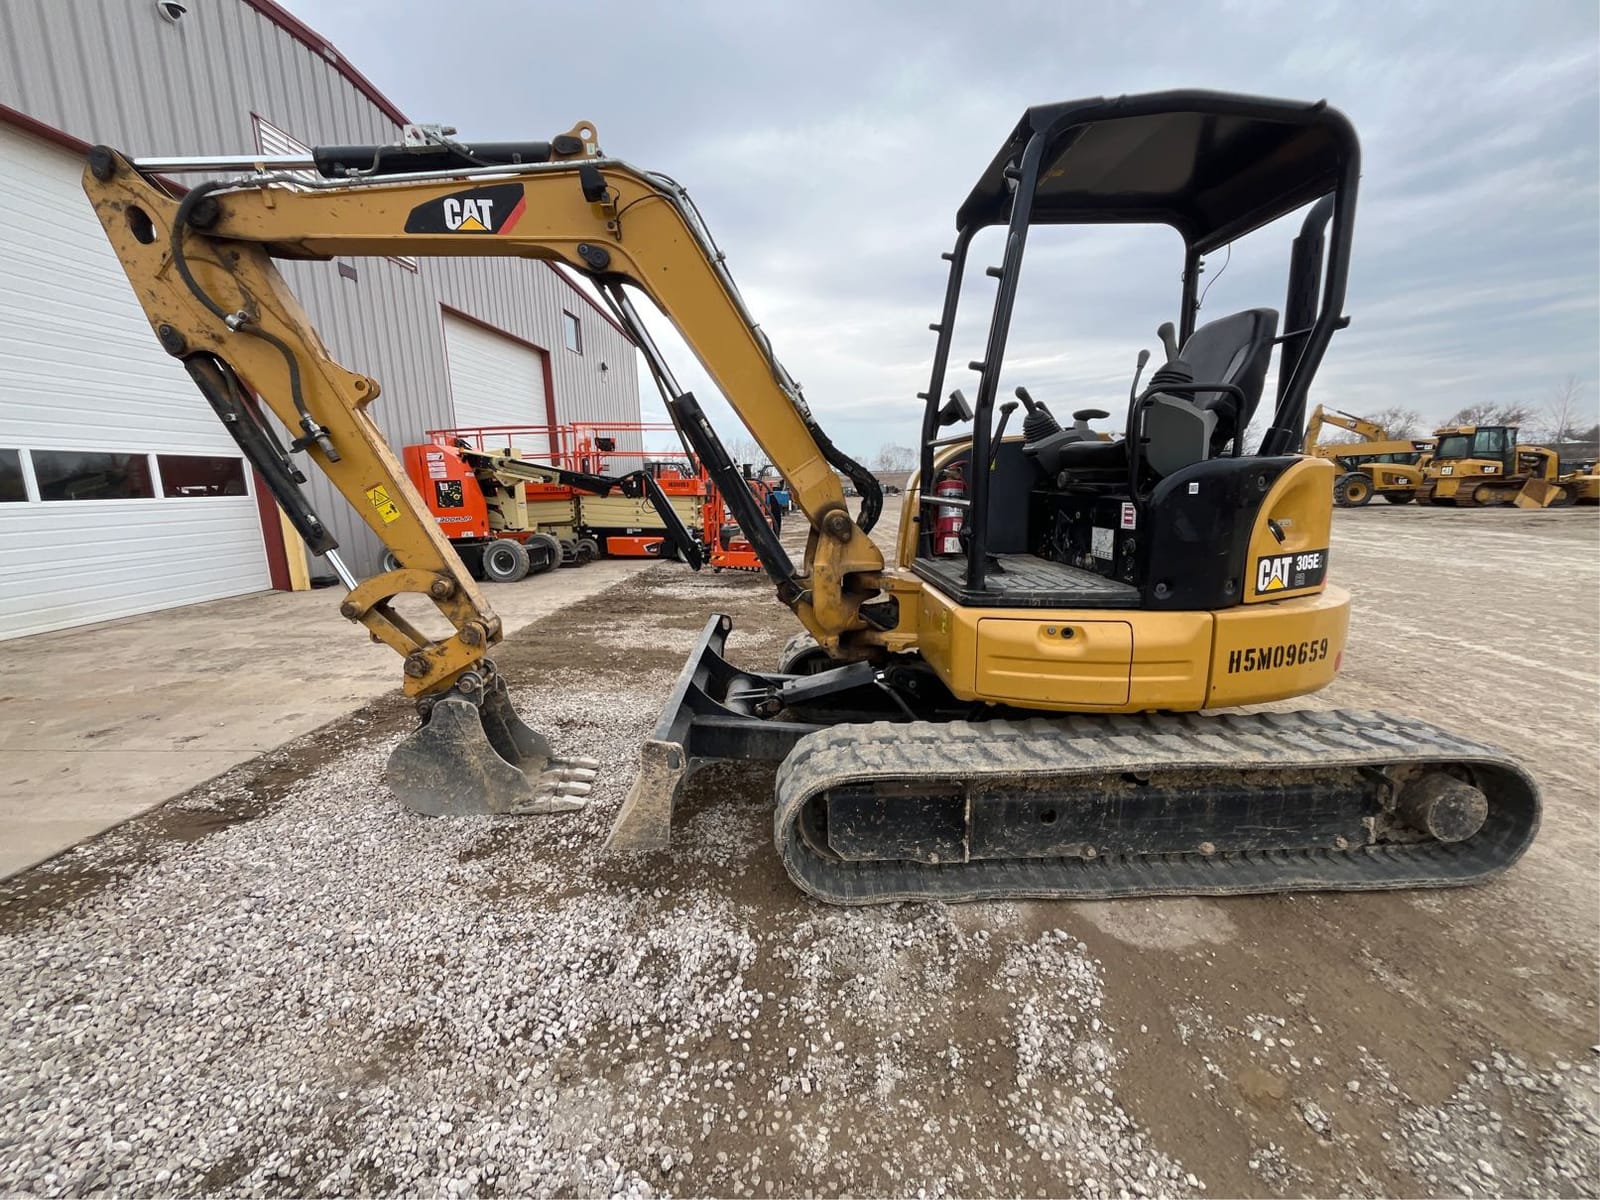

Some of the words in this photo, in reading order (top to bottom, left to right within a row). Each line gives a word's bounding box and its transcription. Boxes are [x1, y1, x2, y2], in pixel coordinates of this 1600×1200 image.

[443, 197, 493, 231] CAT
[1258, 557, 1292, 592] CAT
[1228, 637, 1329, 674] H5M09659
